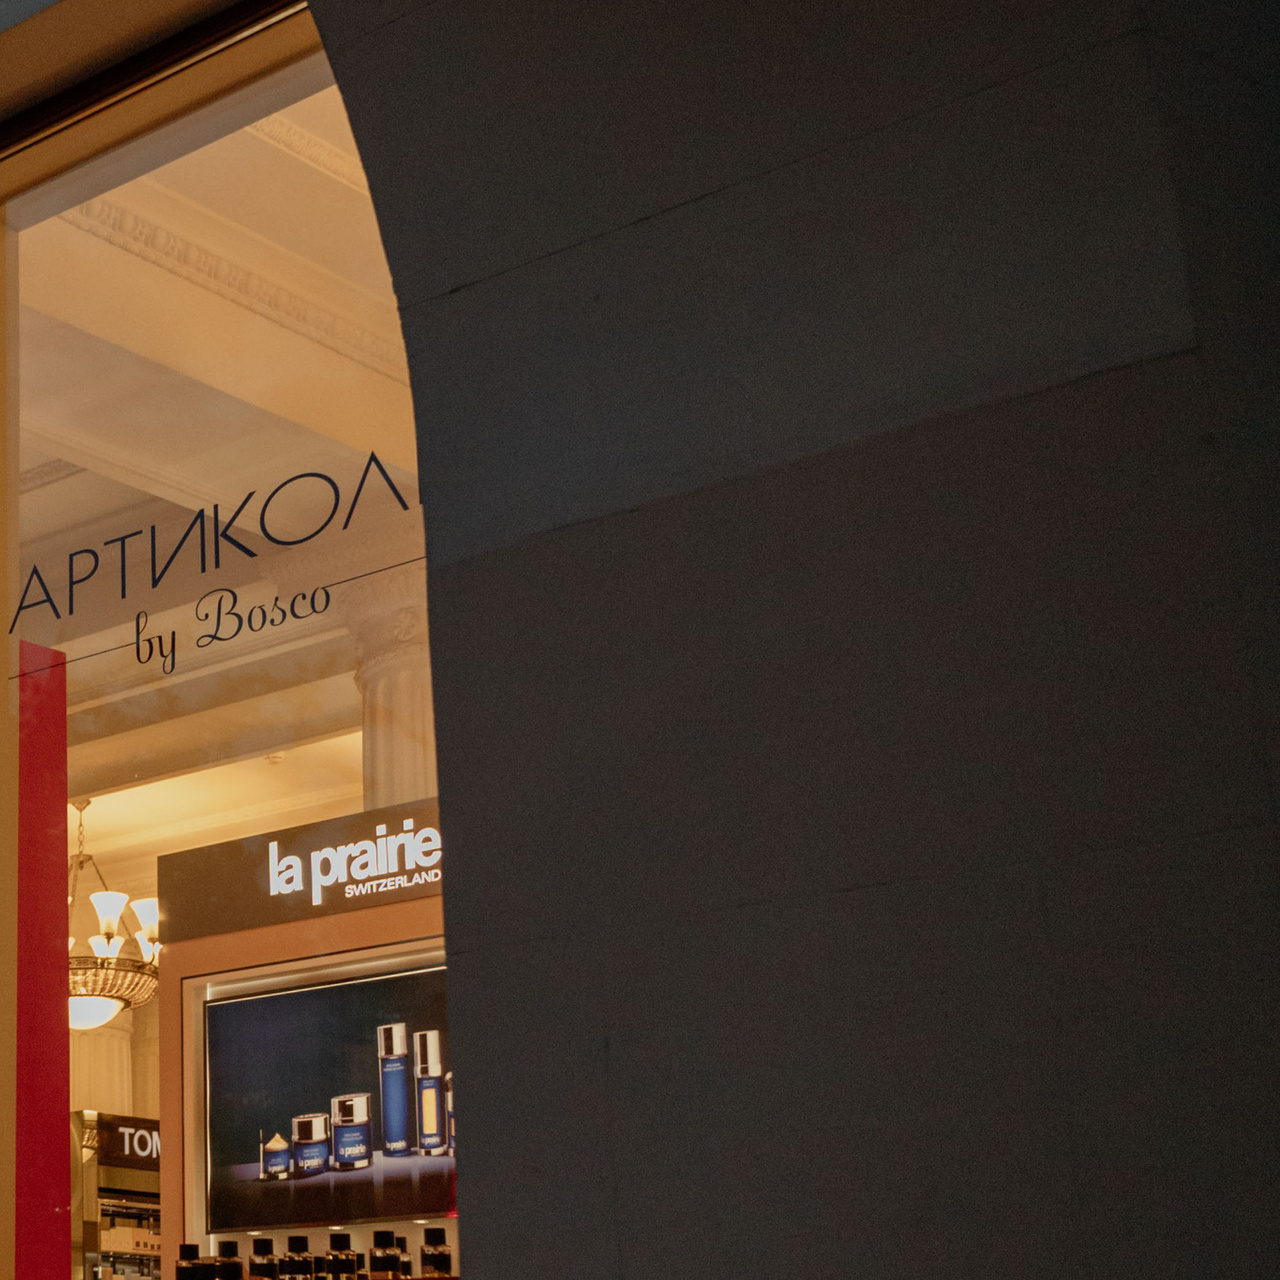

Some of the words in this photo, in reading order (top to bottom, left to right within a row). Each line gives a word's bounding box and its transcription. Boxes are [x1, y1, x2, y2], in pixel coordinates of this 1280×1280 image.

[134, 611, 177, 675] by
[195, 586, 333, 648] Bosco
[268, 840, 304, 896] la
[310, 818, 442, 906] prairie
[344, 869, 442, 898] SWITZERLAND
